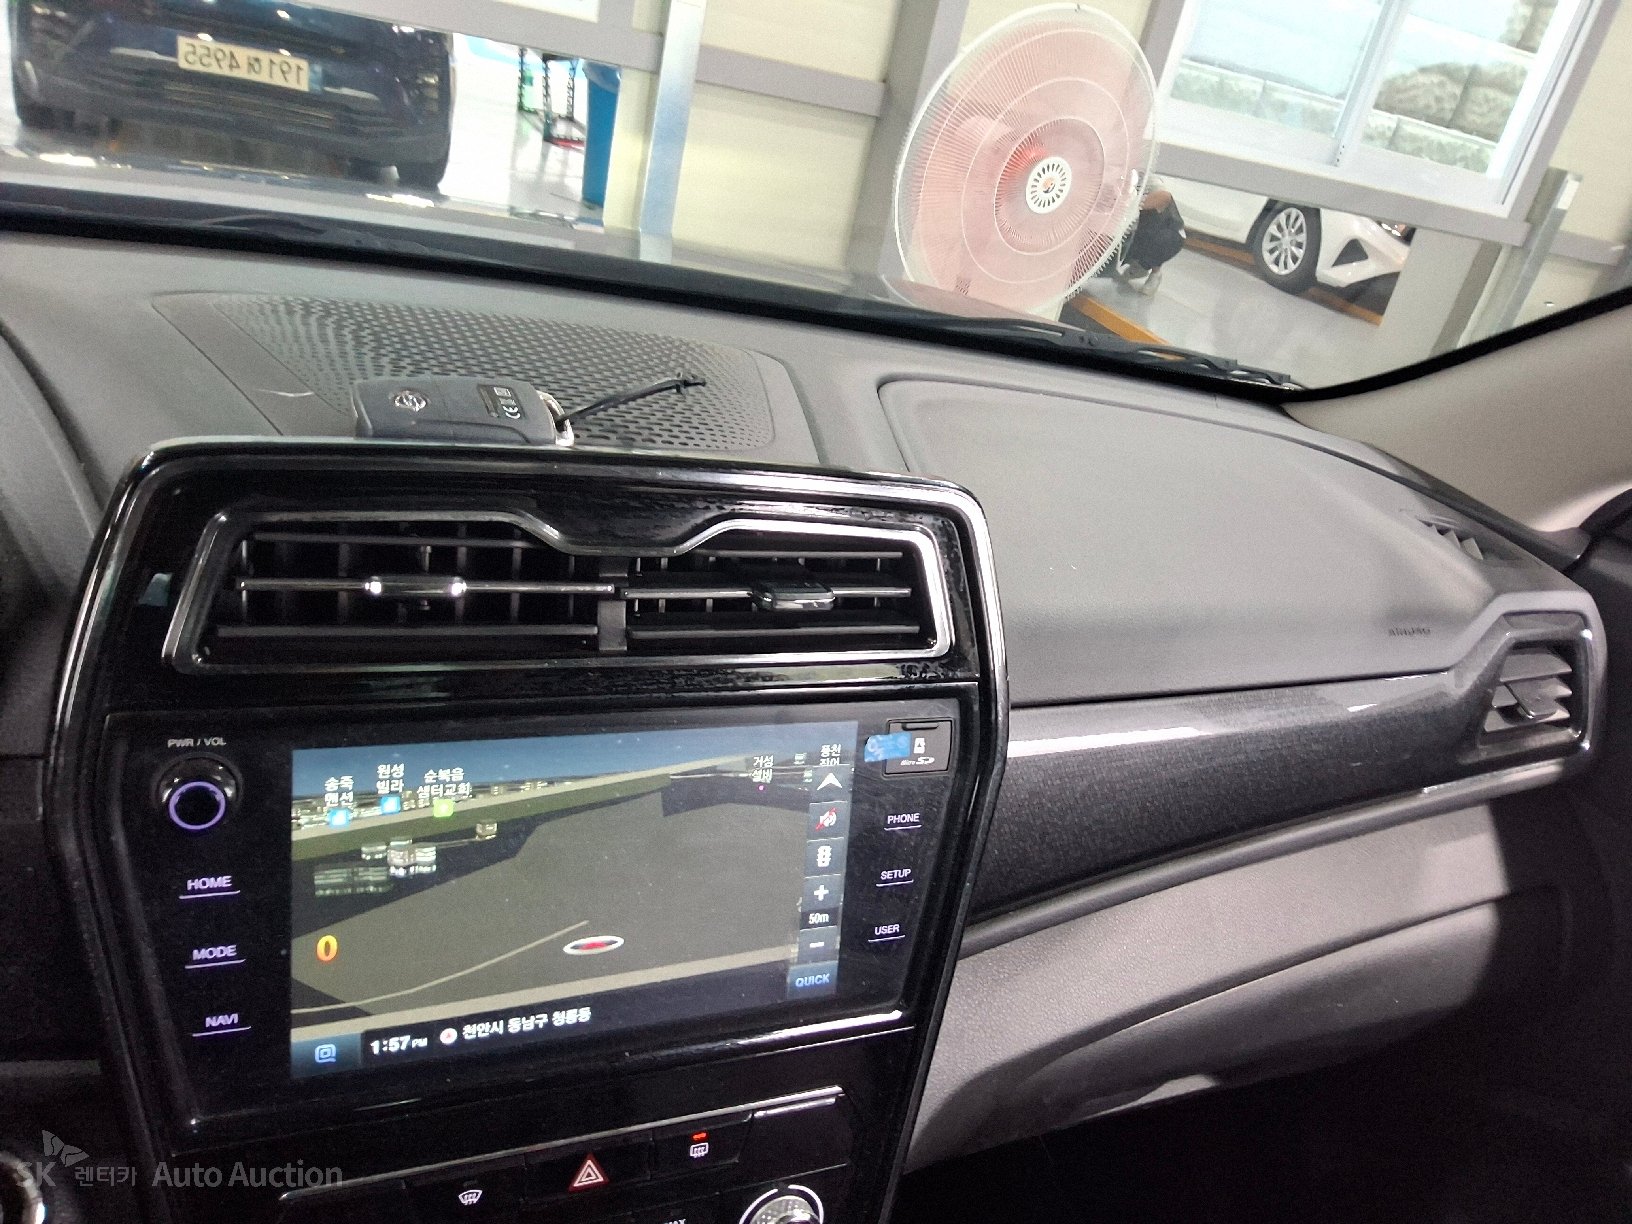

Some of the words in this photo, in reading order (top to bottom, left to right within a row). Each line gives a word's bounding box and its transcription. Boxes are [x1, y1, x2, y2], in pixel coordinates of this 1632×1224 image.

[167, 738, 194, 748] PWR
[203, 736, 227, 746] VOL
[376, 779, 405, 794] 빌라
[887, 813, 921, 825] PHONE
[880, 868, 912, 880] SETUP
[186, 876, 233, 891] HOME
[808, 912, 830, 925] 50m
[874, 924, 900, 936] USER
[192, 944, 237, 960] MODE
[316, 935, 338, 961] 0
[795, 973, 830, 988] QUICK
[205, 1013, 239, 1027] NAVI
[462, 1019, 504, 1040] 천안시
[507, 1013, 549, 1033] 동남구
